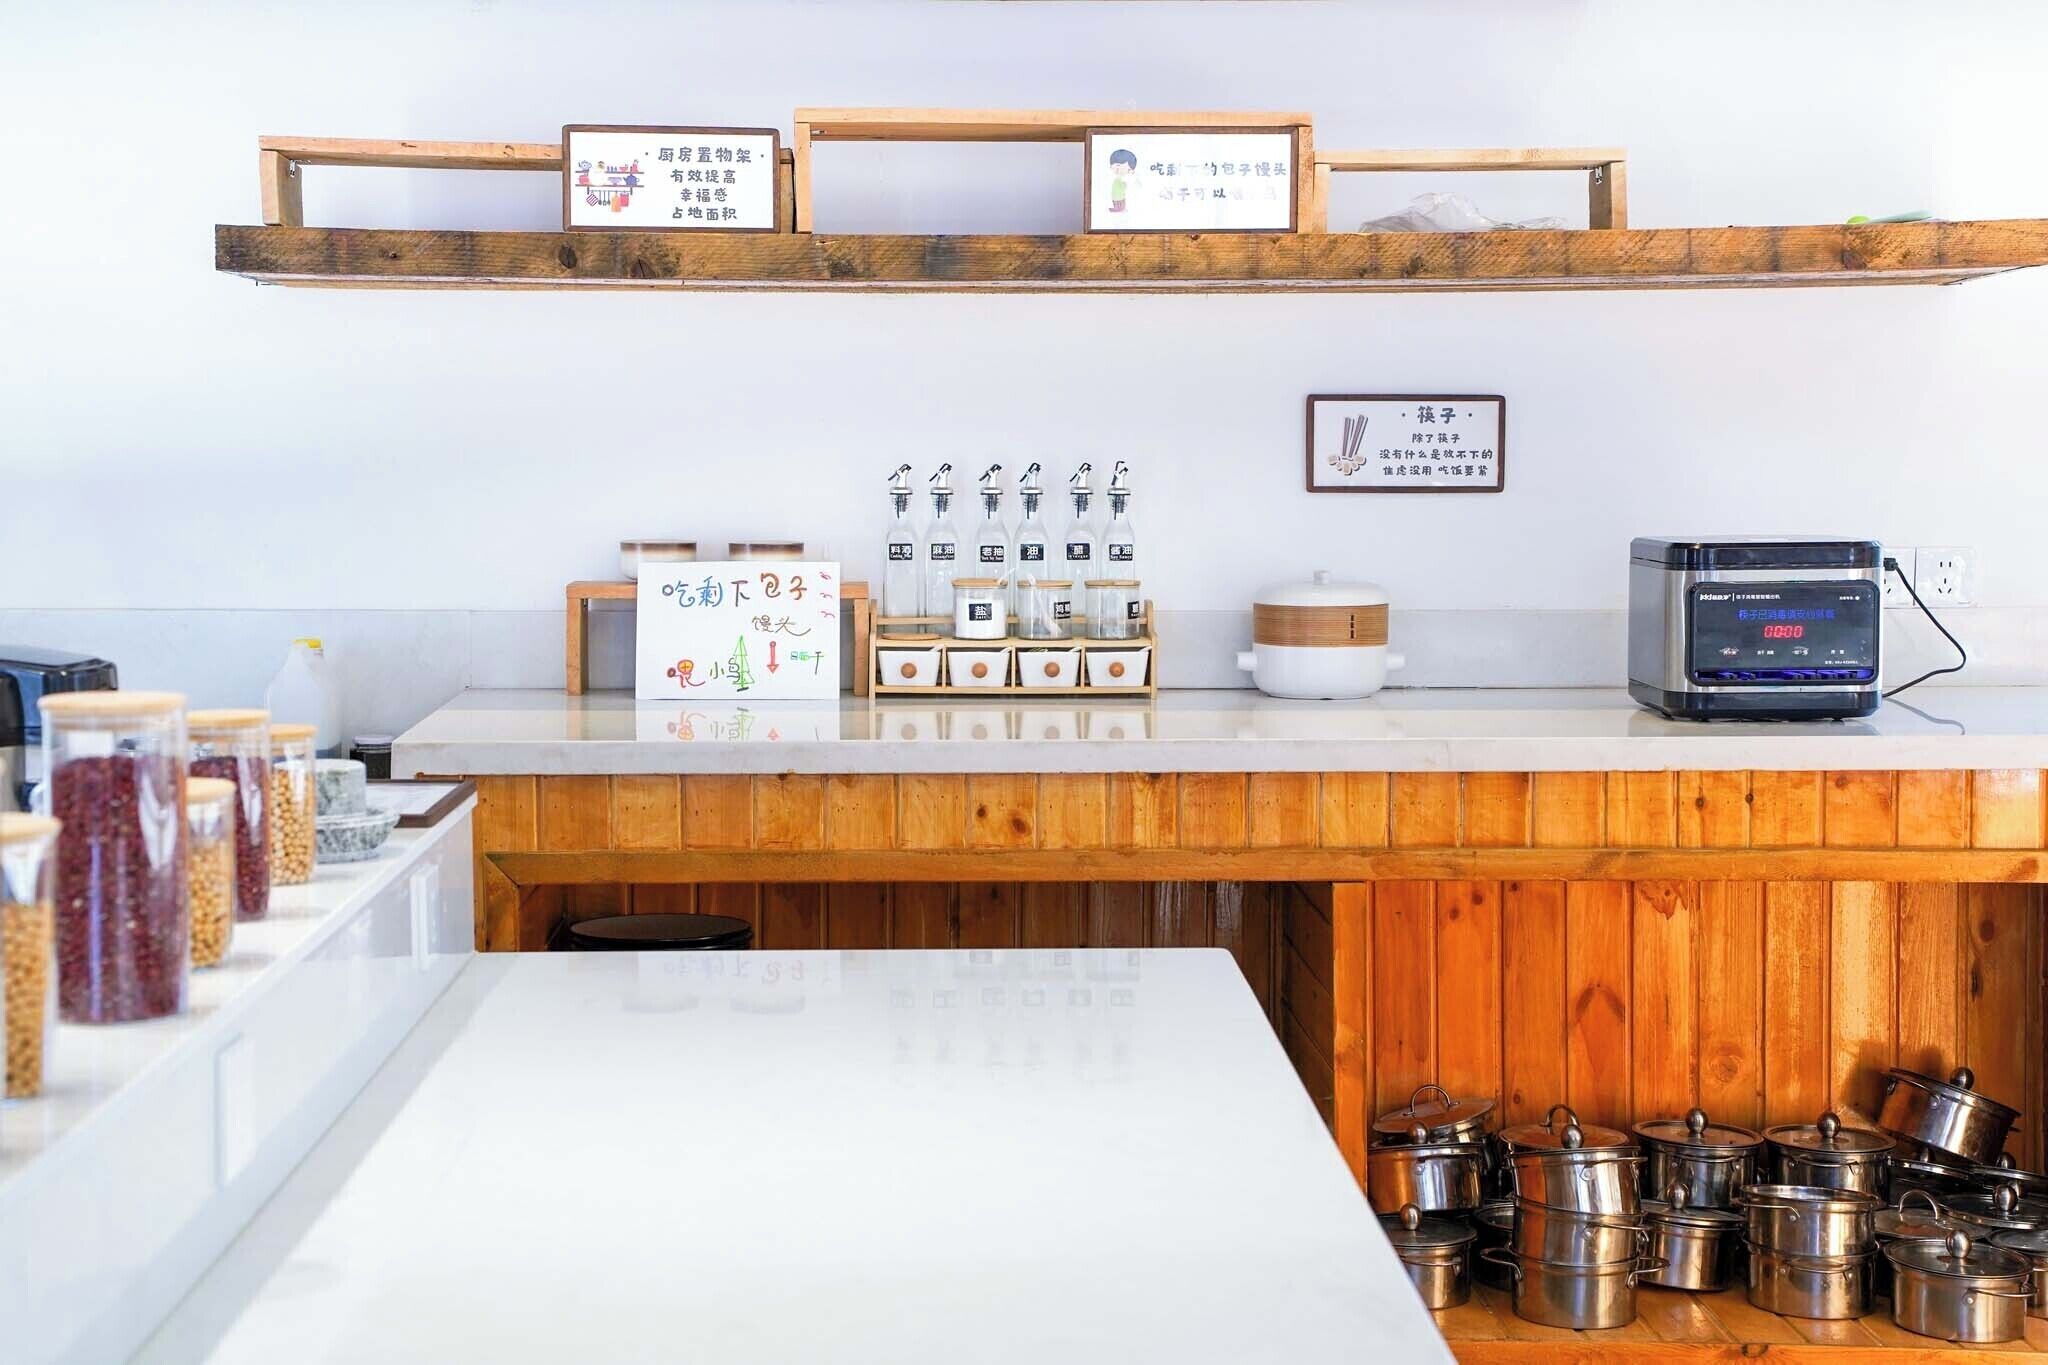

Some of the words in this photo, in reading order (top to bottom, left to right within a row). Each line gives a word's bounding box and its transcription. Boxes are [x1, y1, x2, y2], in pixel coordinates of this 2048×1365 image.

[658, 147, 751, 163] 厨房置物架
[670, 169, 736, 184] 有效提高
[680, 188, 728, 202] 幸福感
[672, 207, 737, 220] 占地面积
[1417, 405, 1456, 424] 筷子
[1411, 433, 1461, 443] 除了筷子
[1379, 449, 1493, 460] 没有什么是放不下的
[1438, 465, 1488, 476] 吃饭要紧
[1026, 545, 1039, 555] 油
[751, 614, 812, 637] 馒头
